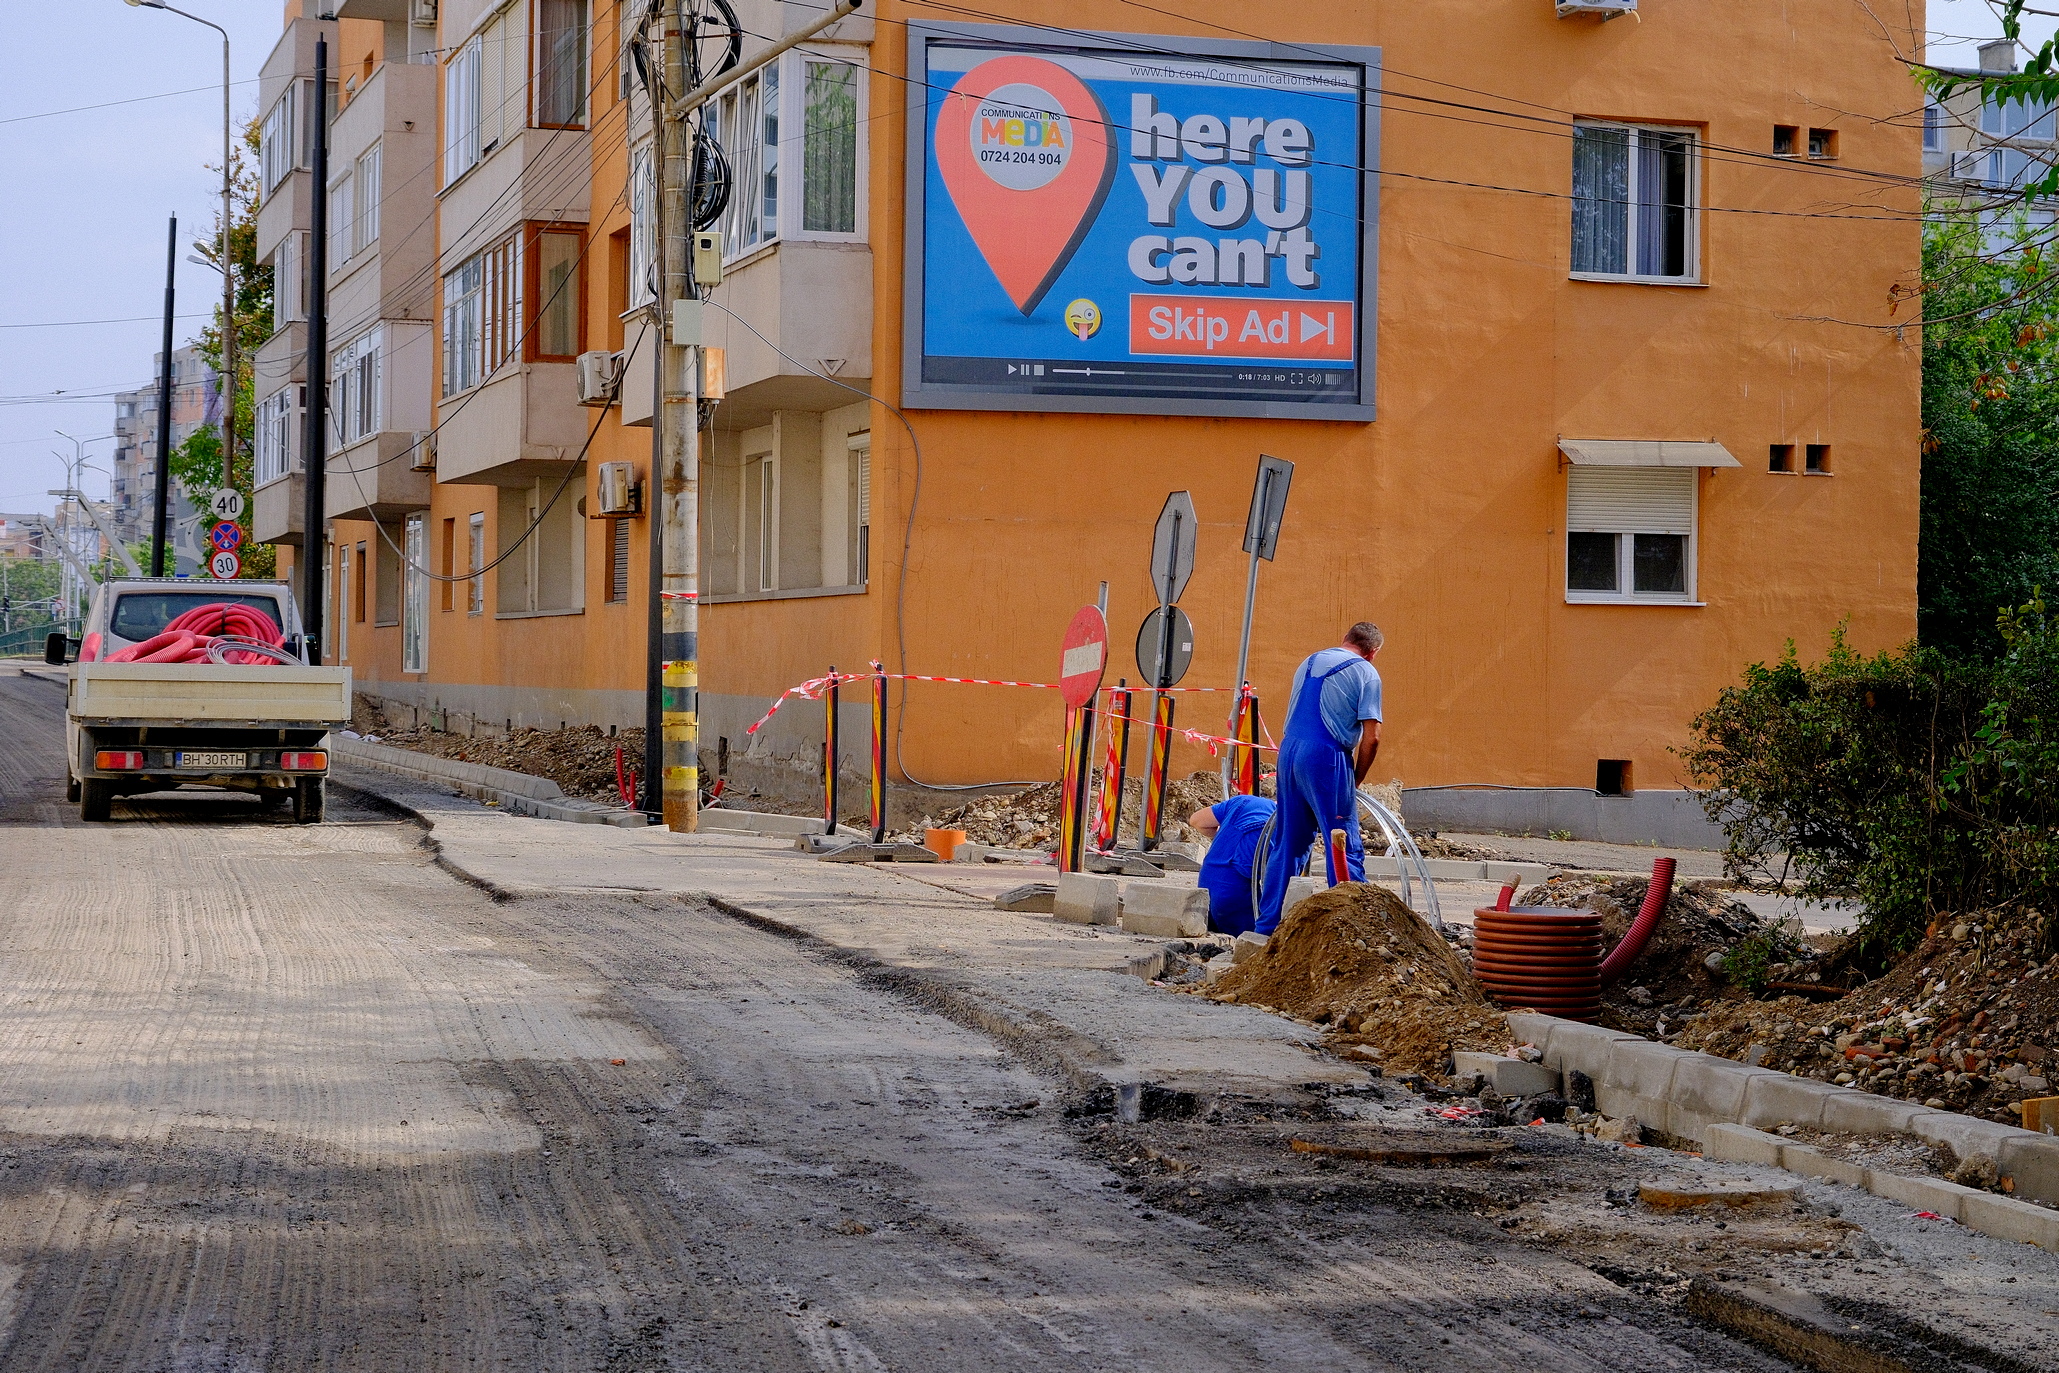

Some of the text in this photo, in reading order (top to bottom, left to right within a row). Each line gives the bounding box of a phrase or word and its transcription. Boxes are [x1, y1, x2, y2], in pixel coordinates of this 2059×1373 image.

[1130, 66, 1348, 87] www.fb.com/CommunicationsMedia
[1131, 93, 1314, 167] here
[981, 150, 1061, 165] 0724 204 904
[1129, 163, 1312, 231] YOU
[1128, 226, 1320, 290] can't
[1148, 306, 1289, 350] Skip Ad
[217, 496, 237, 514] 40
[216, 557, 234, 574] 30
